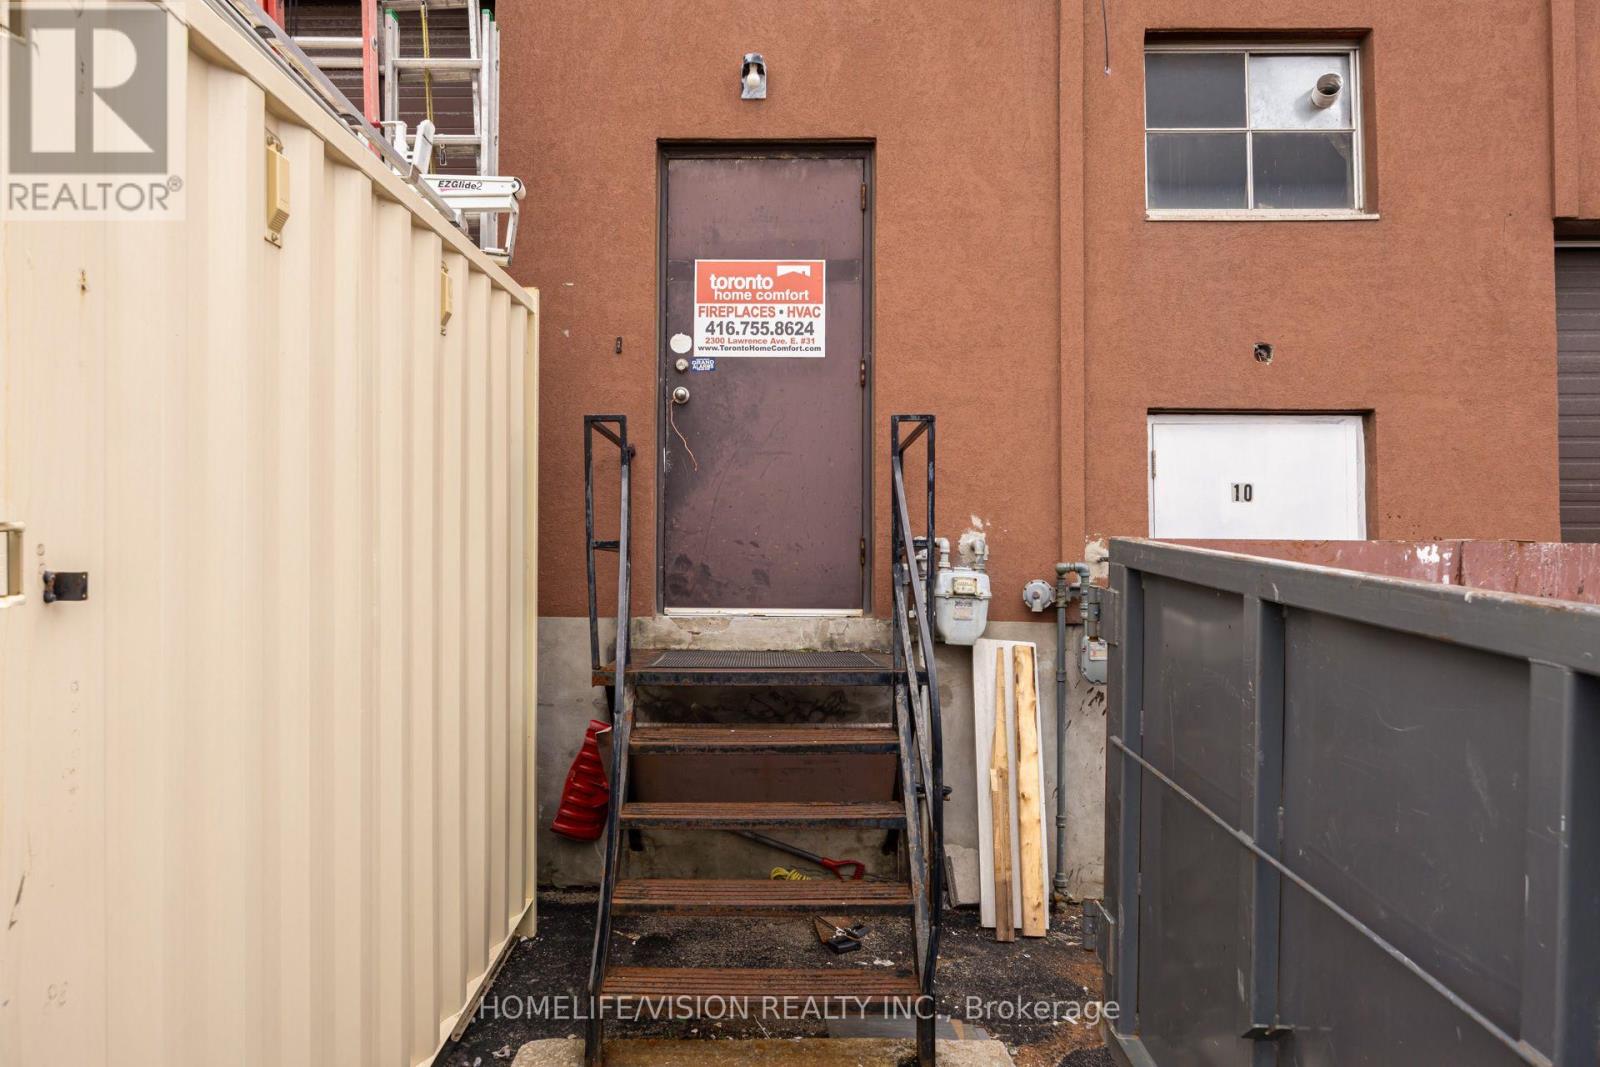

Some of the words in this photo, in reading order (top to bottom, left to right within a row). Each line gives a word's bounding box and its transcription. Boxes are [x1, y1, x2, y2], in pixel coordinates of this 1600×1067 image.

[438, 180, 483, 191] EZGlide2
[709, 274, 774, 290] toronto
[714, 290, 752, 301] home
[756, 289, 809, 301] comfort
[698, 306, 776, 318] FIREPLACES
[787, 306, 821, 318] HVAC
[705, 321, 815, 336] 416.755.8624
[705, 337, 725, 345] 2300
[728, 337, 768, 345] Lawrence
[770, 337, 788, 345] Ave.
[790, 337, 799, 345] E.
[801, 337, 816, 345] #31
[1233, 484, 1252, 502] 10
